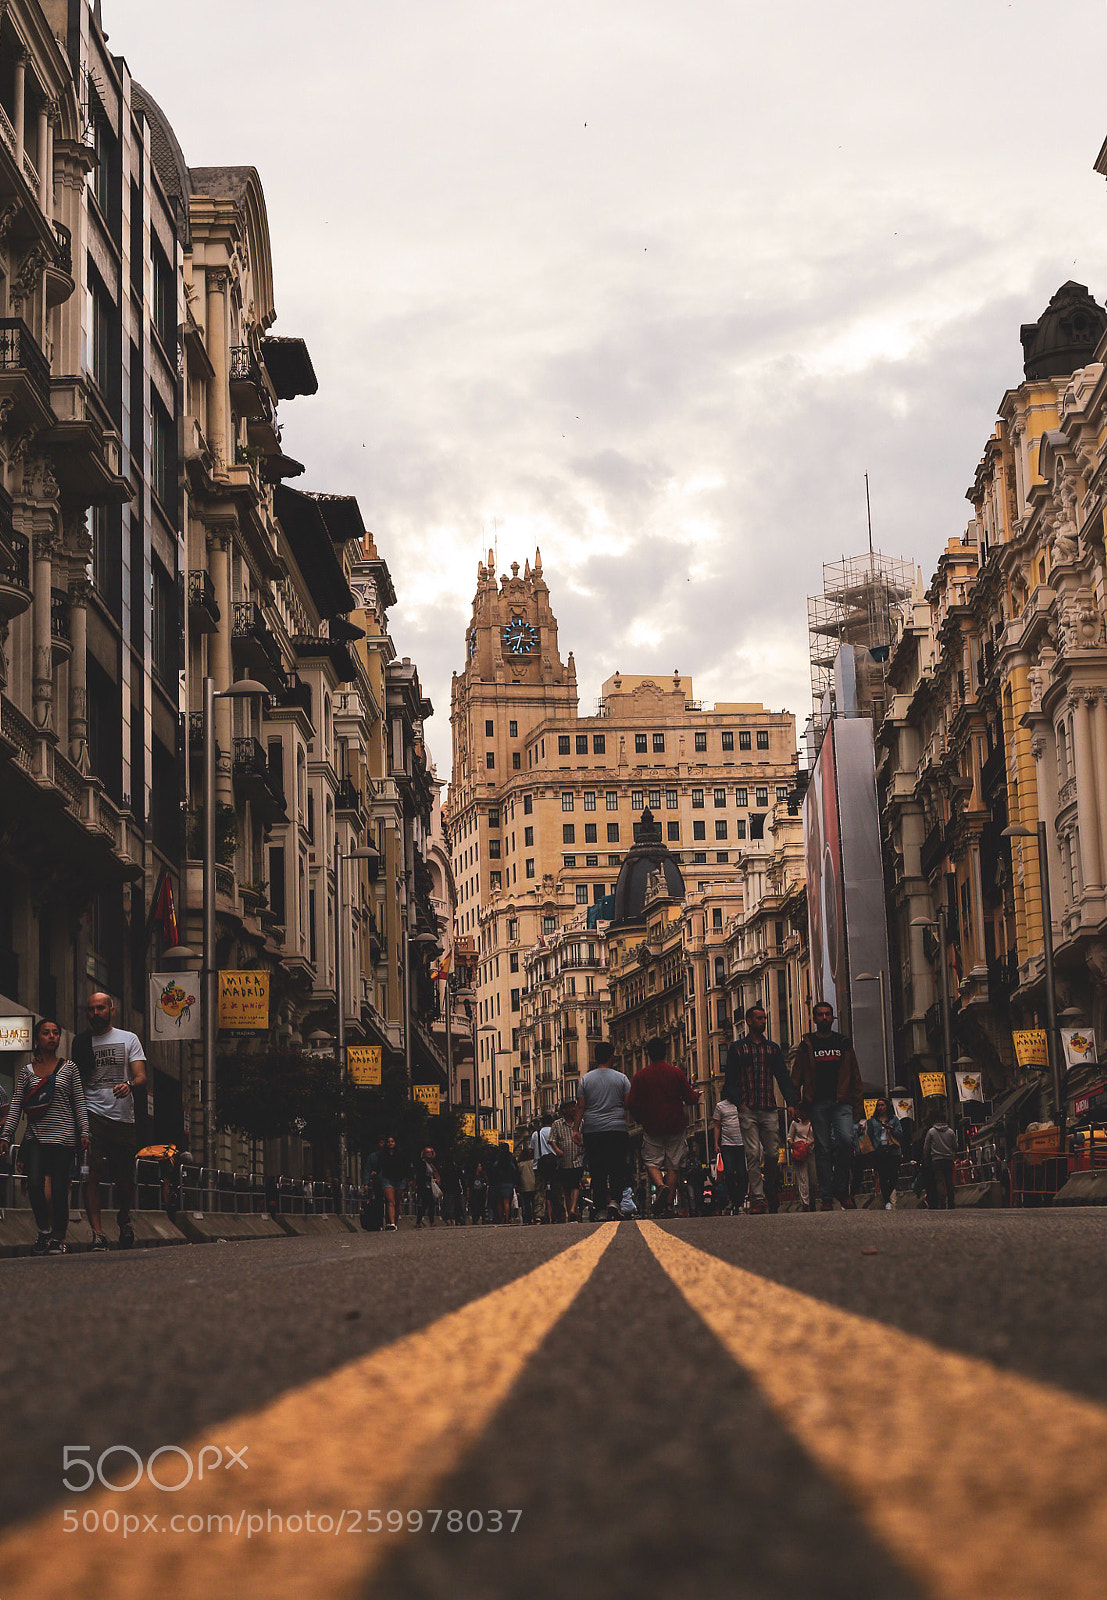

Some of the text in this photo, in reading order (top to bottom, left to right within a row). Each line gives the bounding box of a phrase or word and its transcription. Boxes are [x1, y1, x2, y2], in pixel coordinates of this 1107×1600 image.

[227, 976, 260, 985] MIRA
[223, 987, 265, 997] MADRID
[1016, 1039, 1046, 1047] MADRID
[352, 1049, 376, 1057] MIRA
[350, 1056, 379, 1064] MADRID
